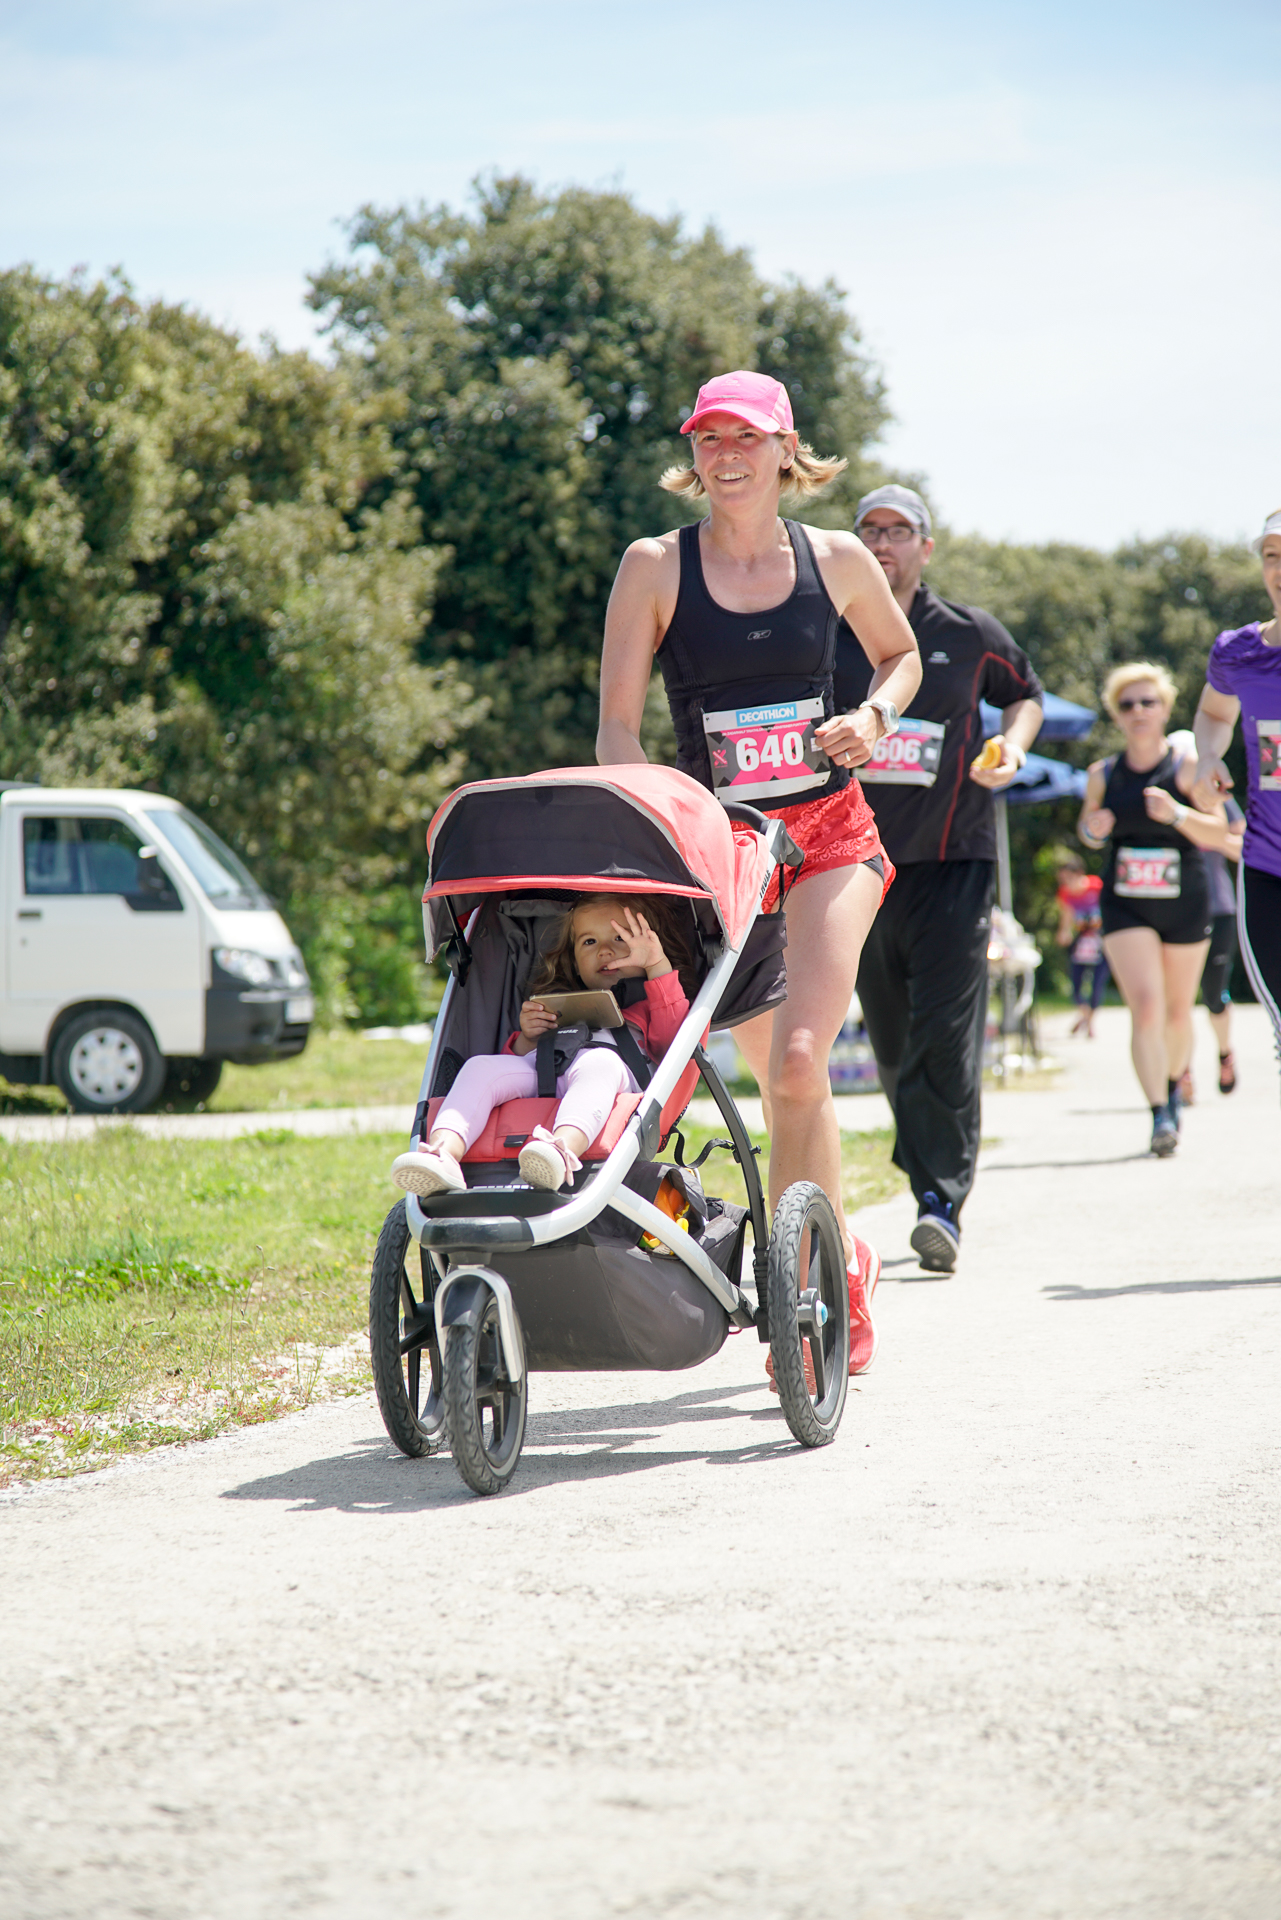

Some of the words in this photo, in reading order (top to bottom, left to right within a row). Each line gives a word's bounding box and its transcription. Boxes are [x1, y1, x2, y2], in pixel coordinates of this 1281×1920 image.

[739, 706, 795, 723] DECATHLON
[735, 731, 804, 772] 640
[873, 737, 922, 765] 606
